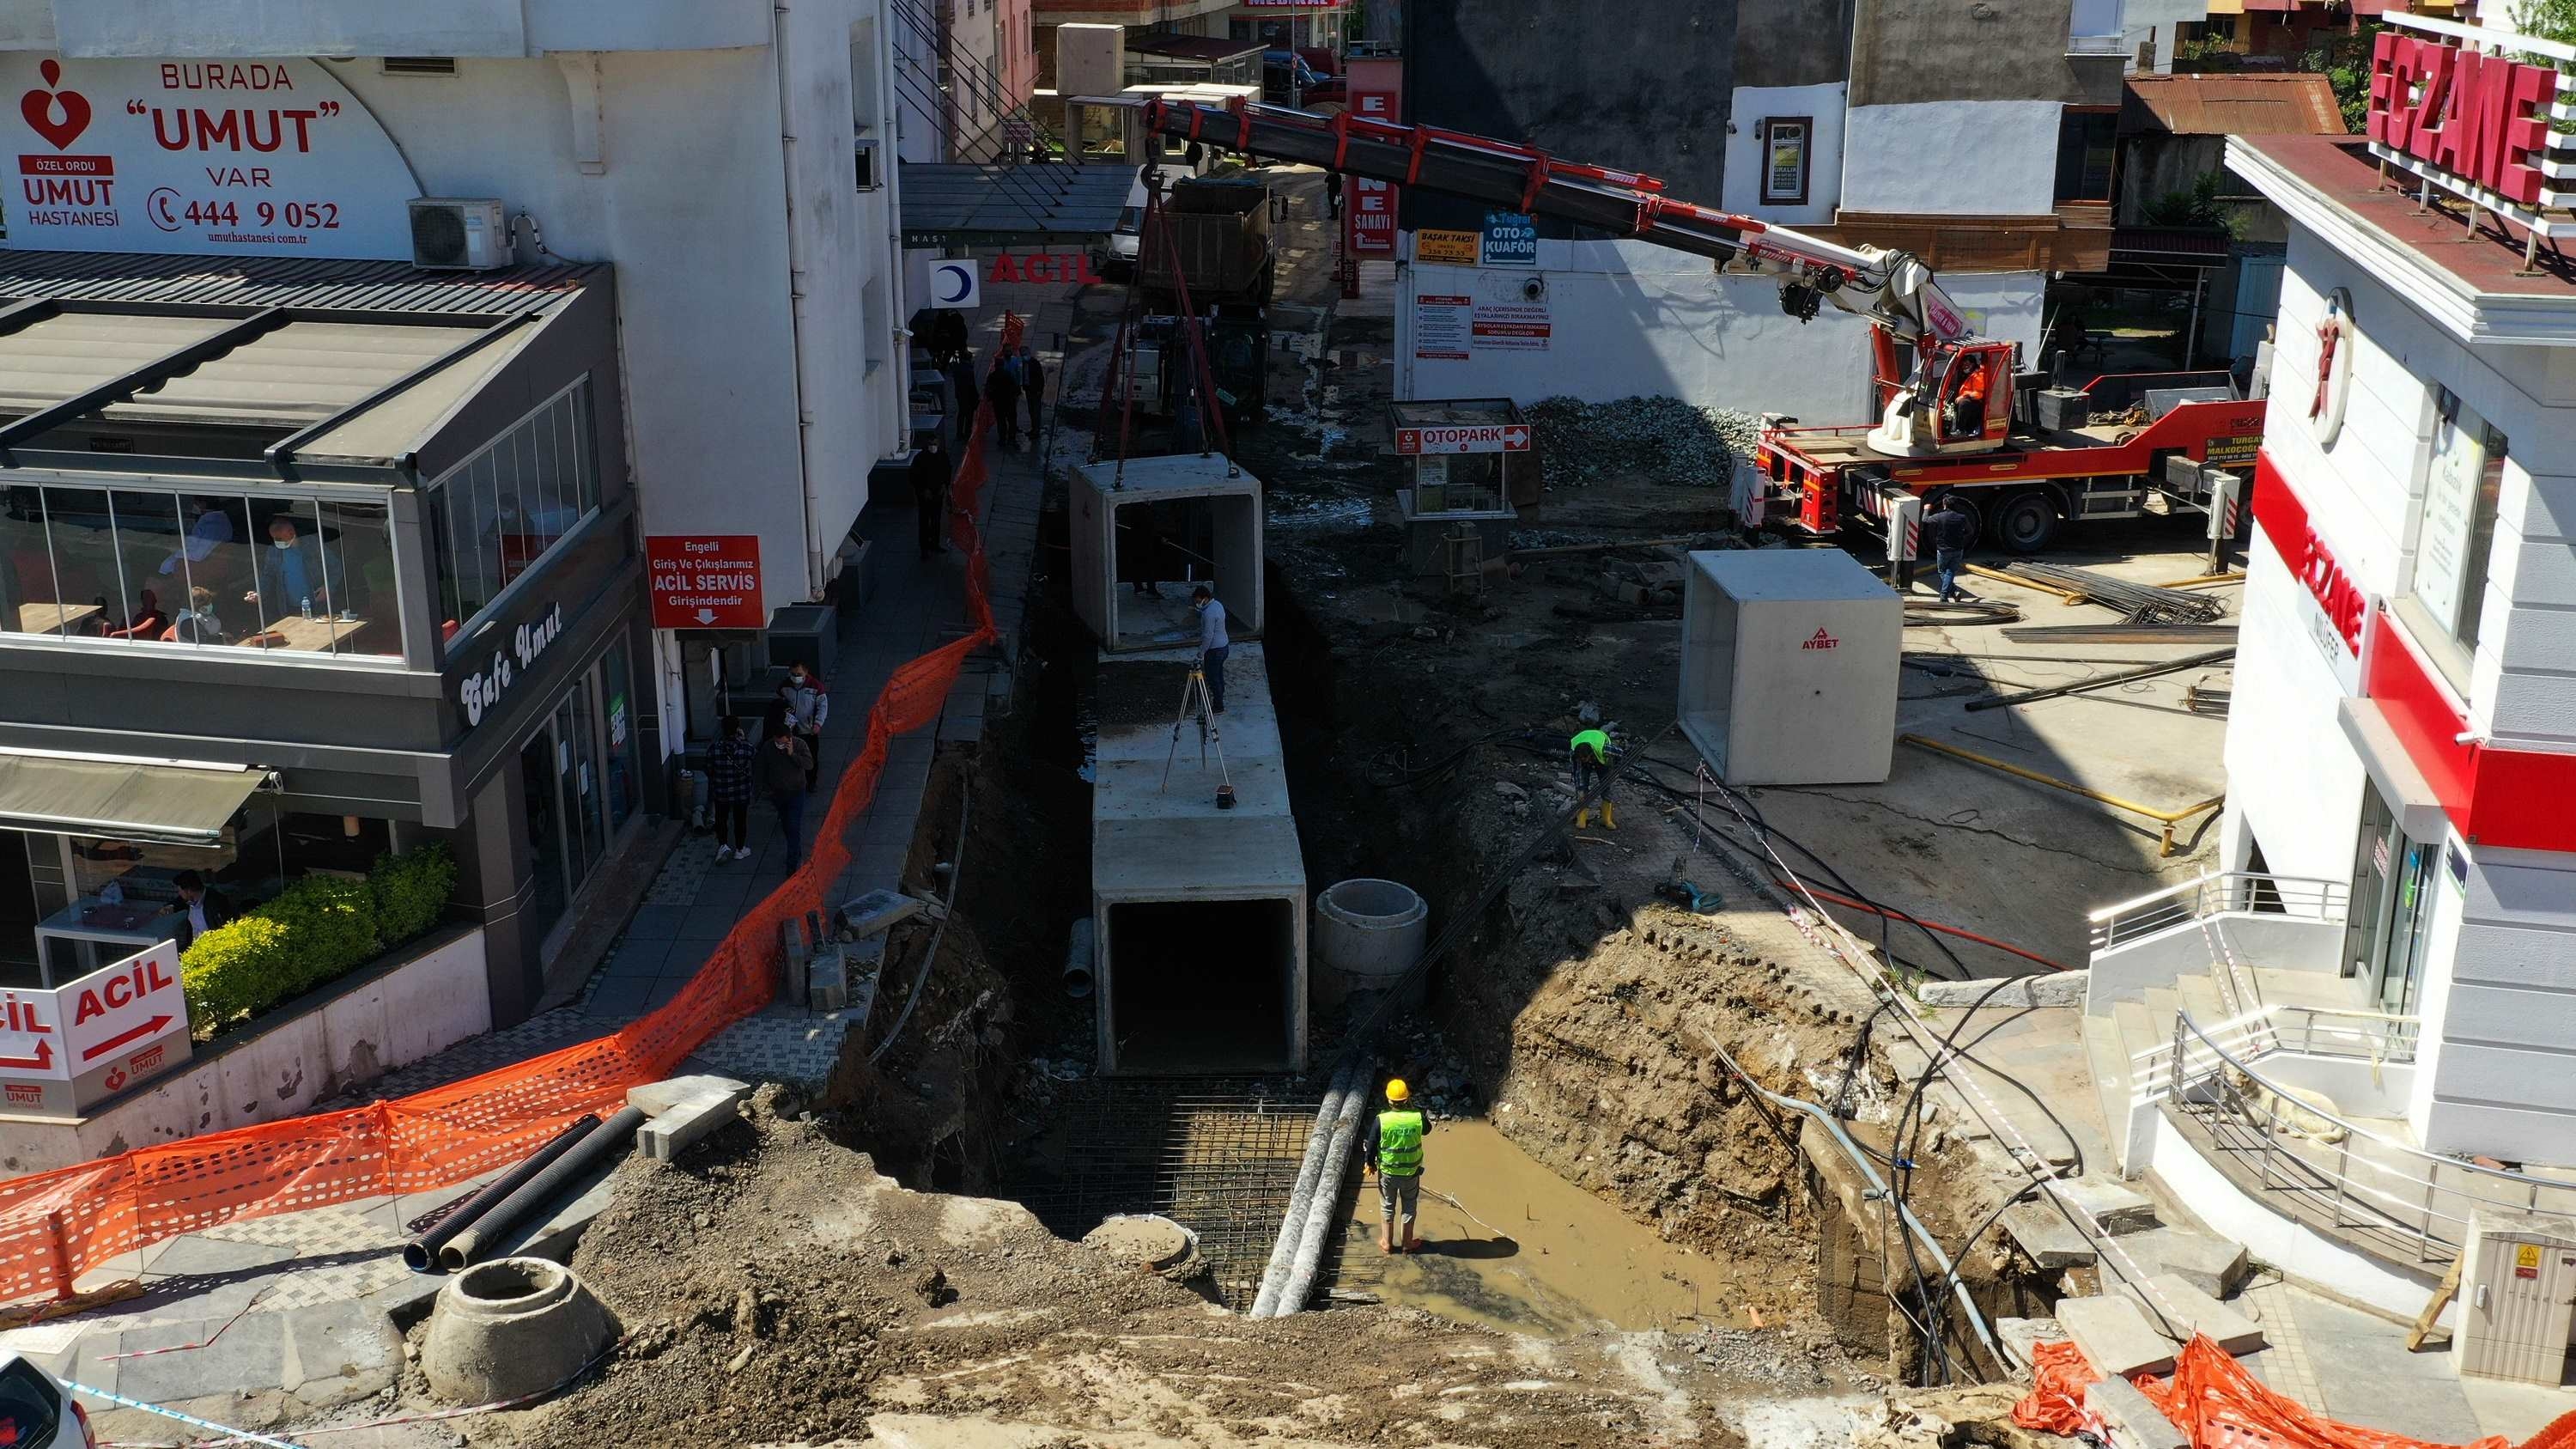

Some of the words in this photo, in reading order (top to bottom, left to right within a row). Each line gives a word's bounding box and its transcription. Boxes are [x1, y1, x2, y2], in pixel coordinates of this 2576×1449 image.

[161, 64, 294, 90] BURADA
[2366, 32, 2557, 203] ECZANE
[36, 159, 64, 171] ÖZEL
[65, 161, 96, 171] ORDU
[205, 167, 273, 188] VAR
[23, 179, 114, 206] UMUT
[28, 210, 119, 227] HASTANESİ
[185, 200, 240, 227] 444
[256, 201, 276, 228] 9
[284, 202, 340, 229] 052
[1492, 227, 1520, 239] OTO
[1485, 239, 1535, 253] KUAFÖR
[1424, 428, 1502, 443] OTOPARK
[684, 541, 720, 554] Engelli
[653, 559, 677, 571] Giriş
[679, 559, 692, 569] Ve
[695, 558, 754, 571] Çıkışlarımız
[654, 571, 692, 591] ACİL
[696, 571, 755, 591] SERVİS
[668, 595, 743, 608] Girişindendir
[2300, 526, 2366, 661] ECZANE
[1801, 638, 1838, 650] AYBET
[460, 650, 511, 727] Cafe
[75, 959, 173, 1026] ACİL
[131, 1052, 163, 1075] UMUT
[6, 1092, 42, 1103] UMUT
